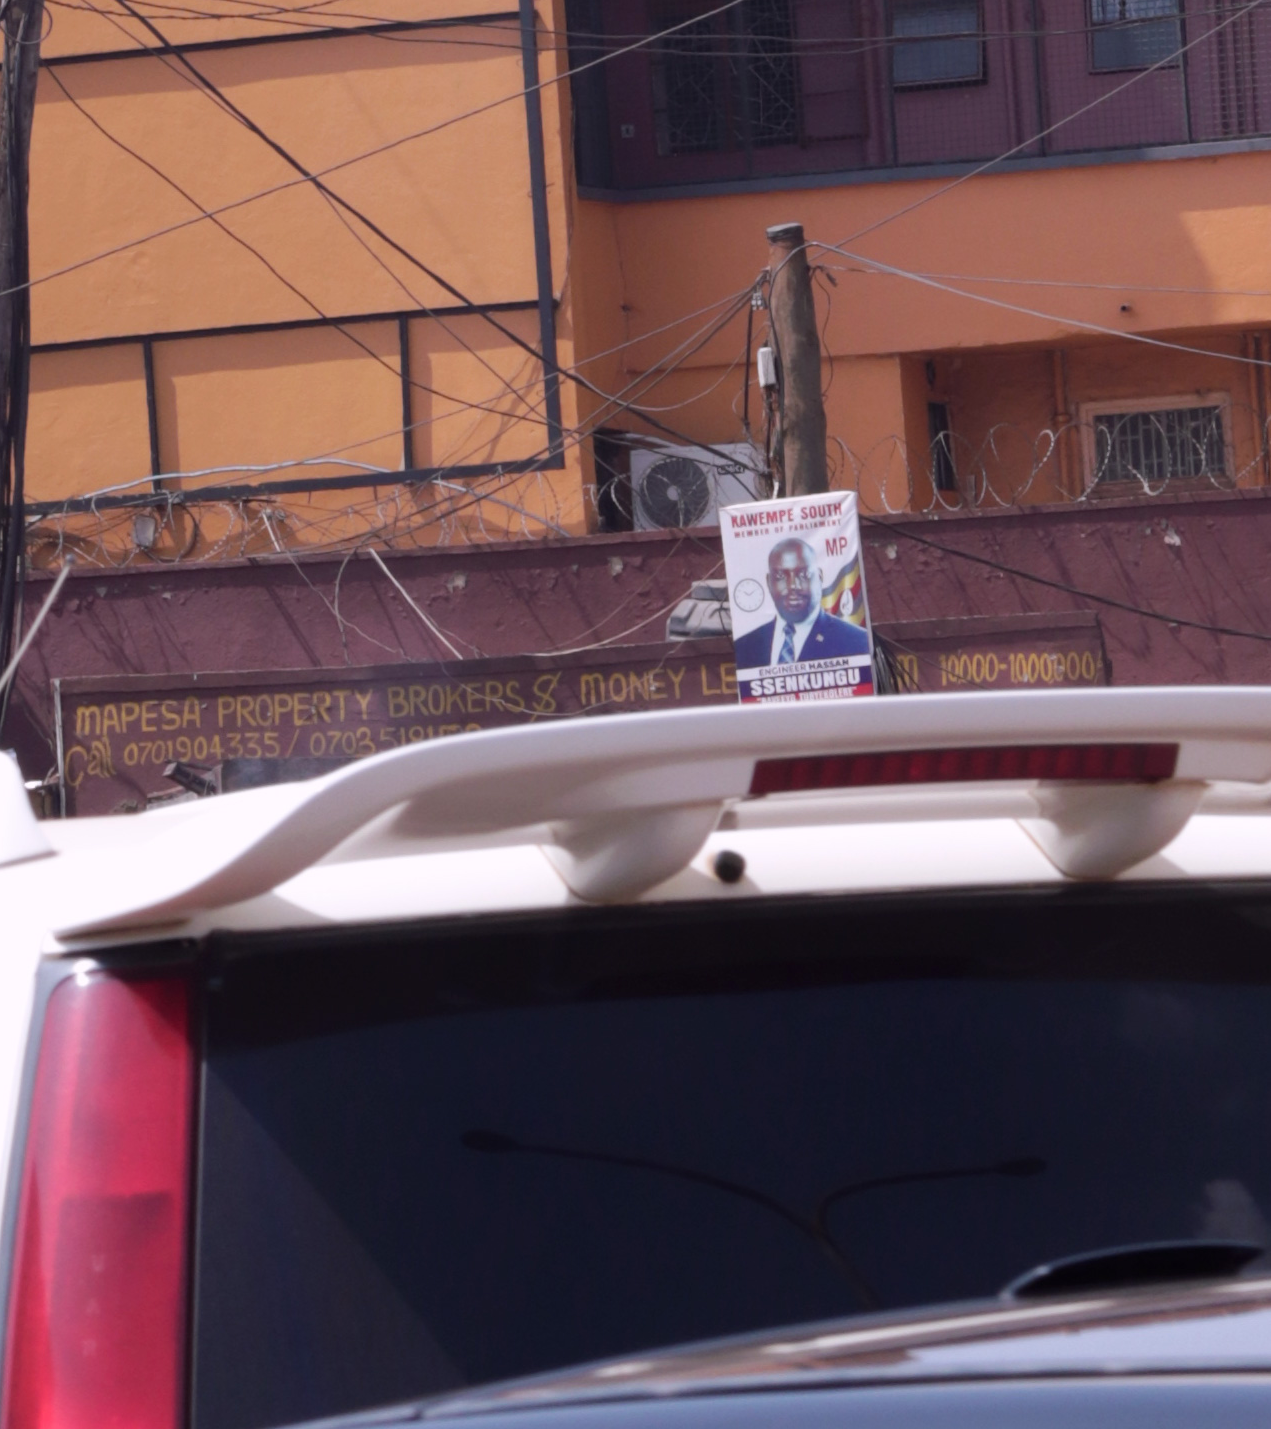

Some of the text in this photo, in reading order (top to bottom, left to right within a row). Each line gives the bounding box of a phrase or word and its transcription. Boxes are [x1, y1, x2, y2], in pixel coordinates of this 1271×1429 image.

[731, 502, 842, 529] KAWEMPE SOUTH
[734, 519, 842, 539] MEMBER OF PARLIAMENT
[826, 536, 848, 557] MP
[759, 658, 849, 677] ENGINEER HASSAN
[750, 667, 860, 697] SSENKUNGU
[76, 666, 686, 736] MAPESA PROPERTY BROKERS MONEY
[123, 732, 280, 768] 0701904335
